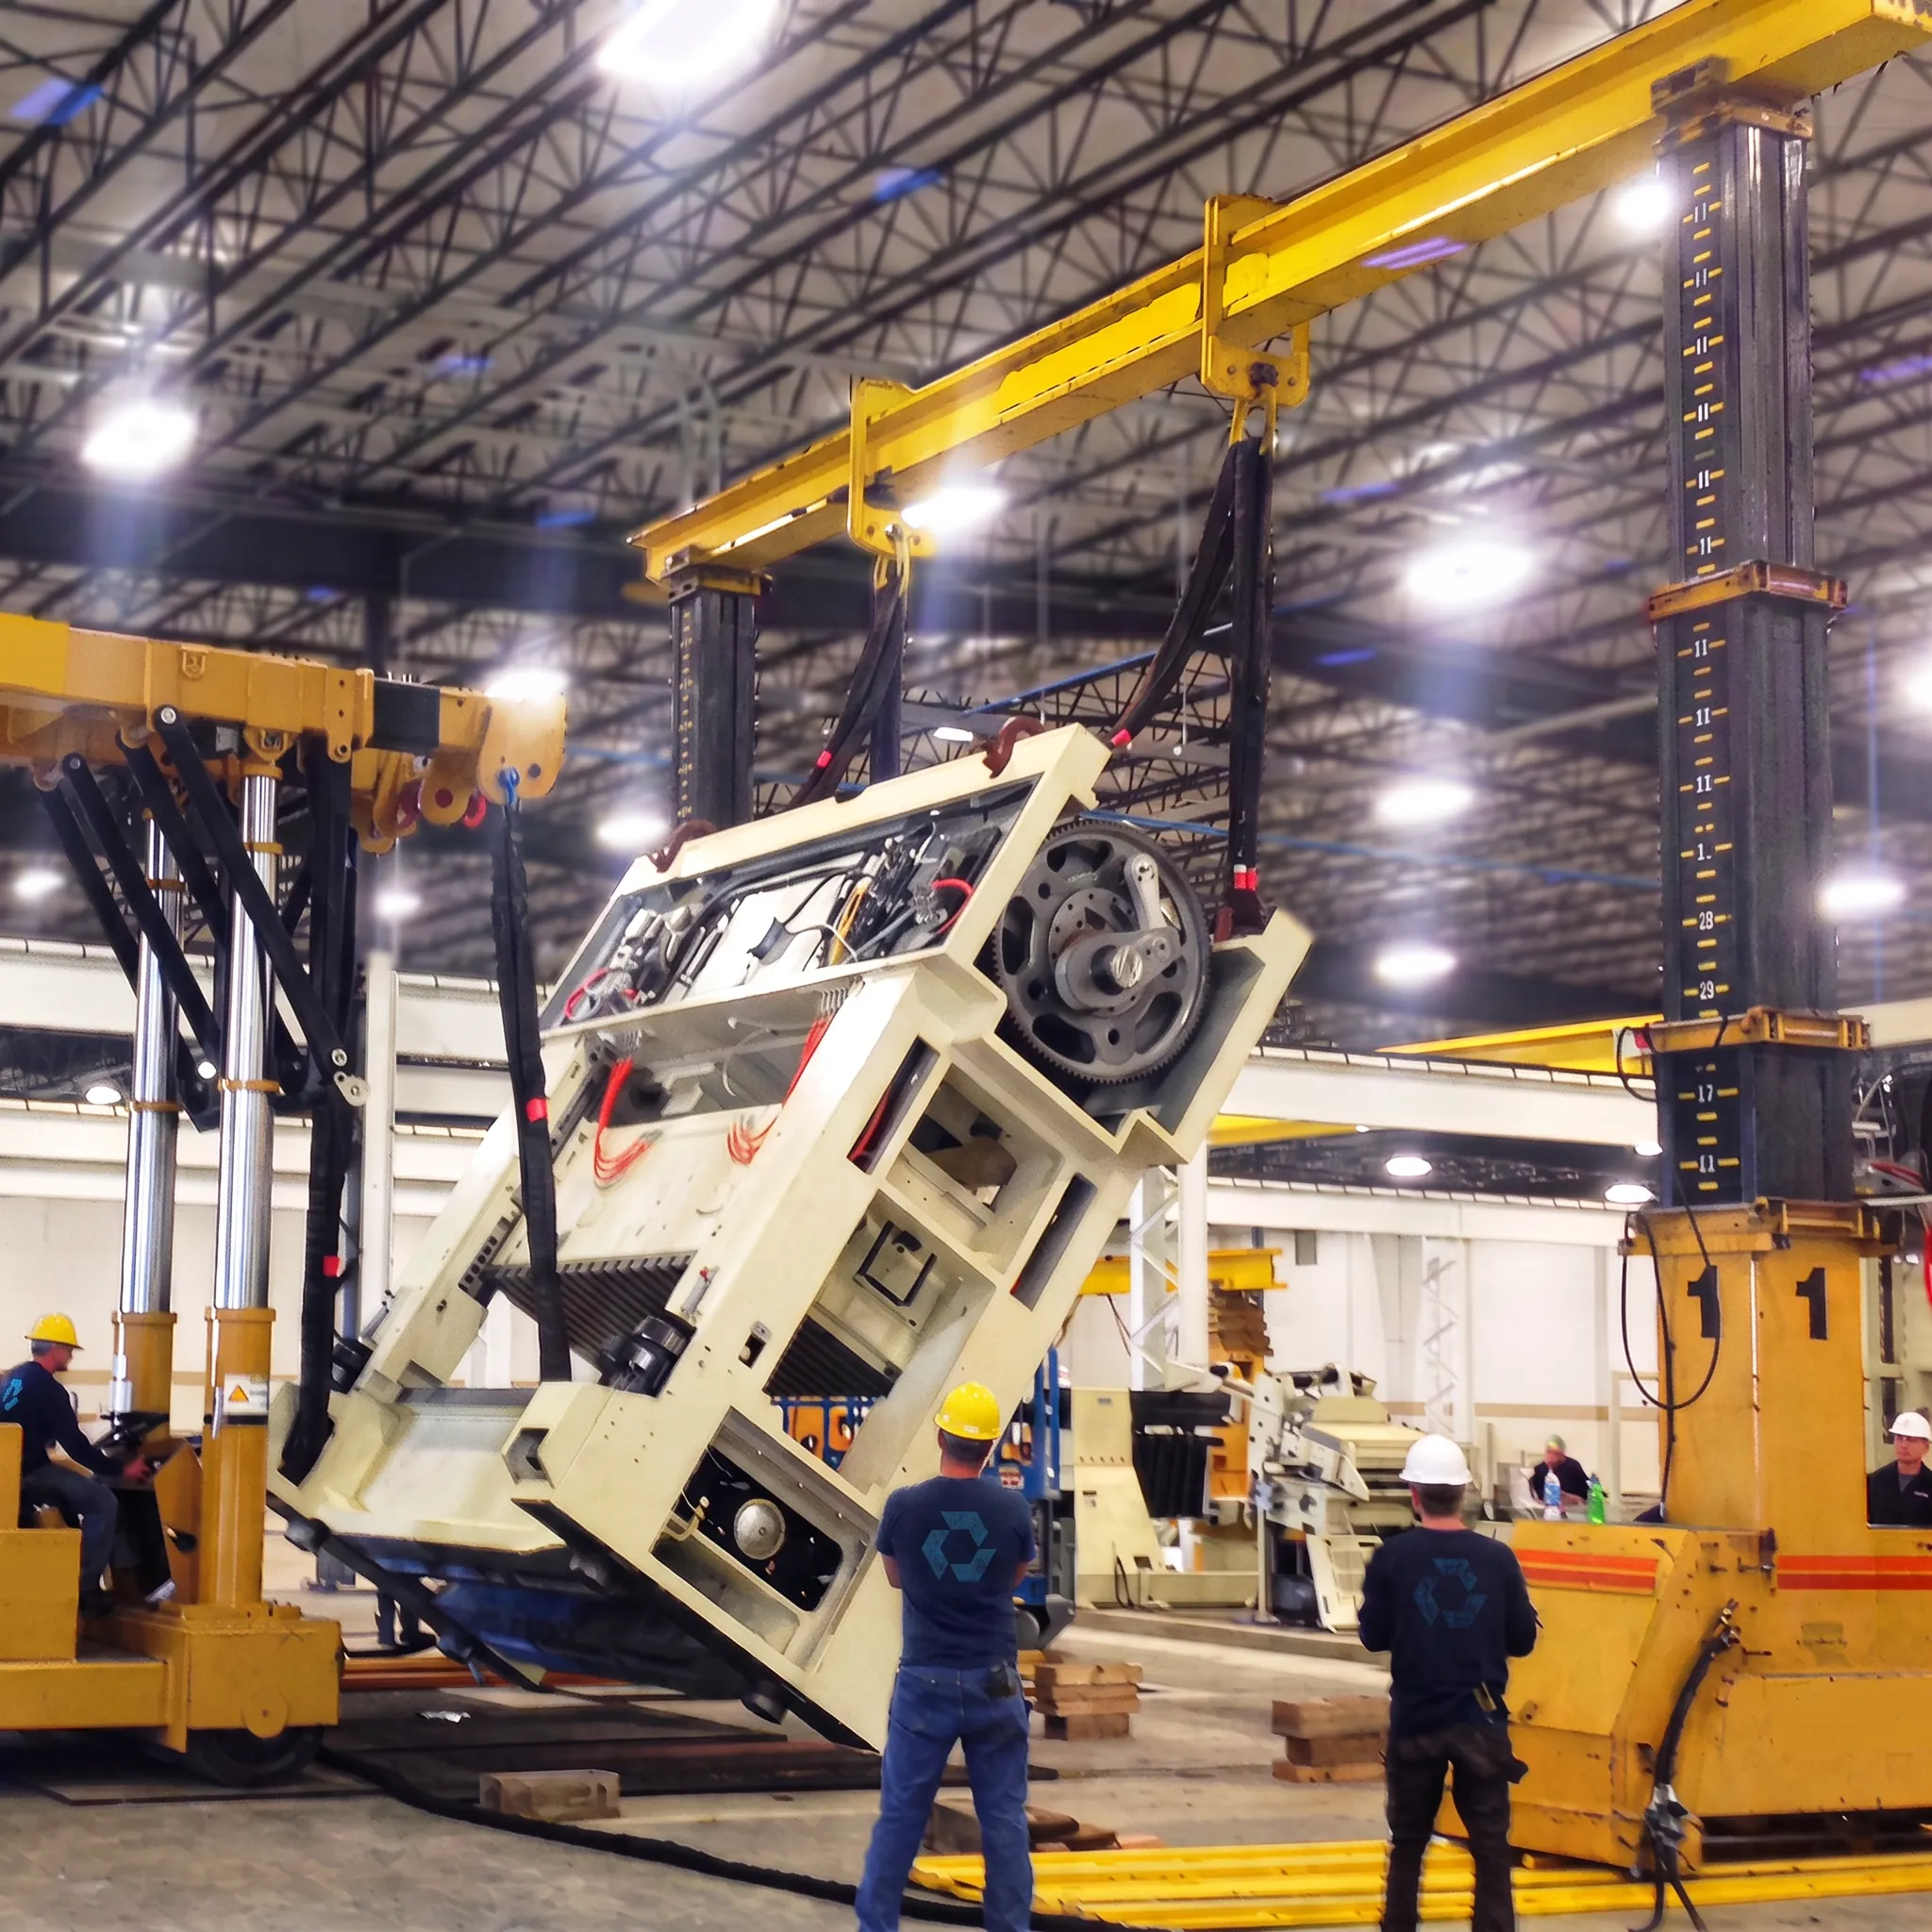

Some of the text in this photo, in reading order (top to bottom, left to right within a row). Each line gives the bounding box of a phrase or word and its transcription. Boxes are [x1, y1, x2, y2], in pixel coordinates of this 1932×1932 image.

[1699, 909, 1714, 931] 28
[1699, 979, 1715, 1001] 29
[1698, 1084, 1714, 1104] 17
[1687, 1265, 1721, 1339] 1
[1795, 1267, 1828, 1341] 1
